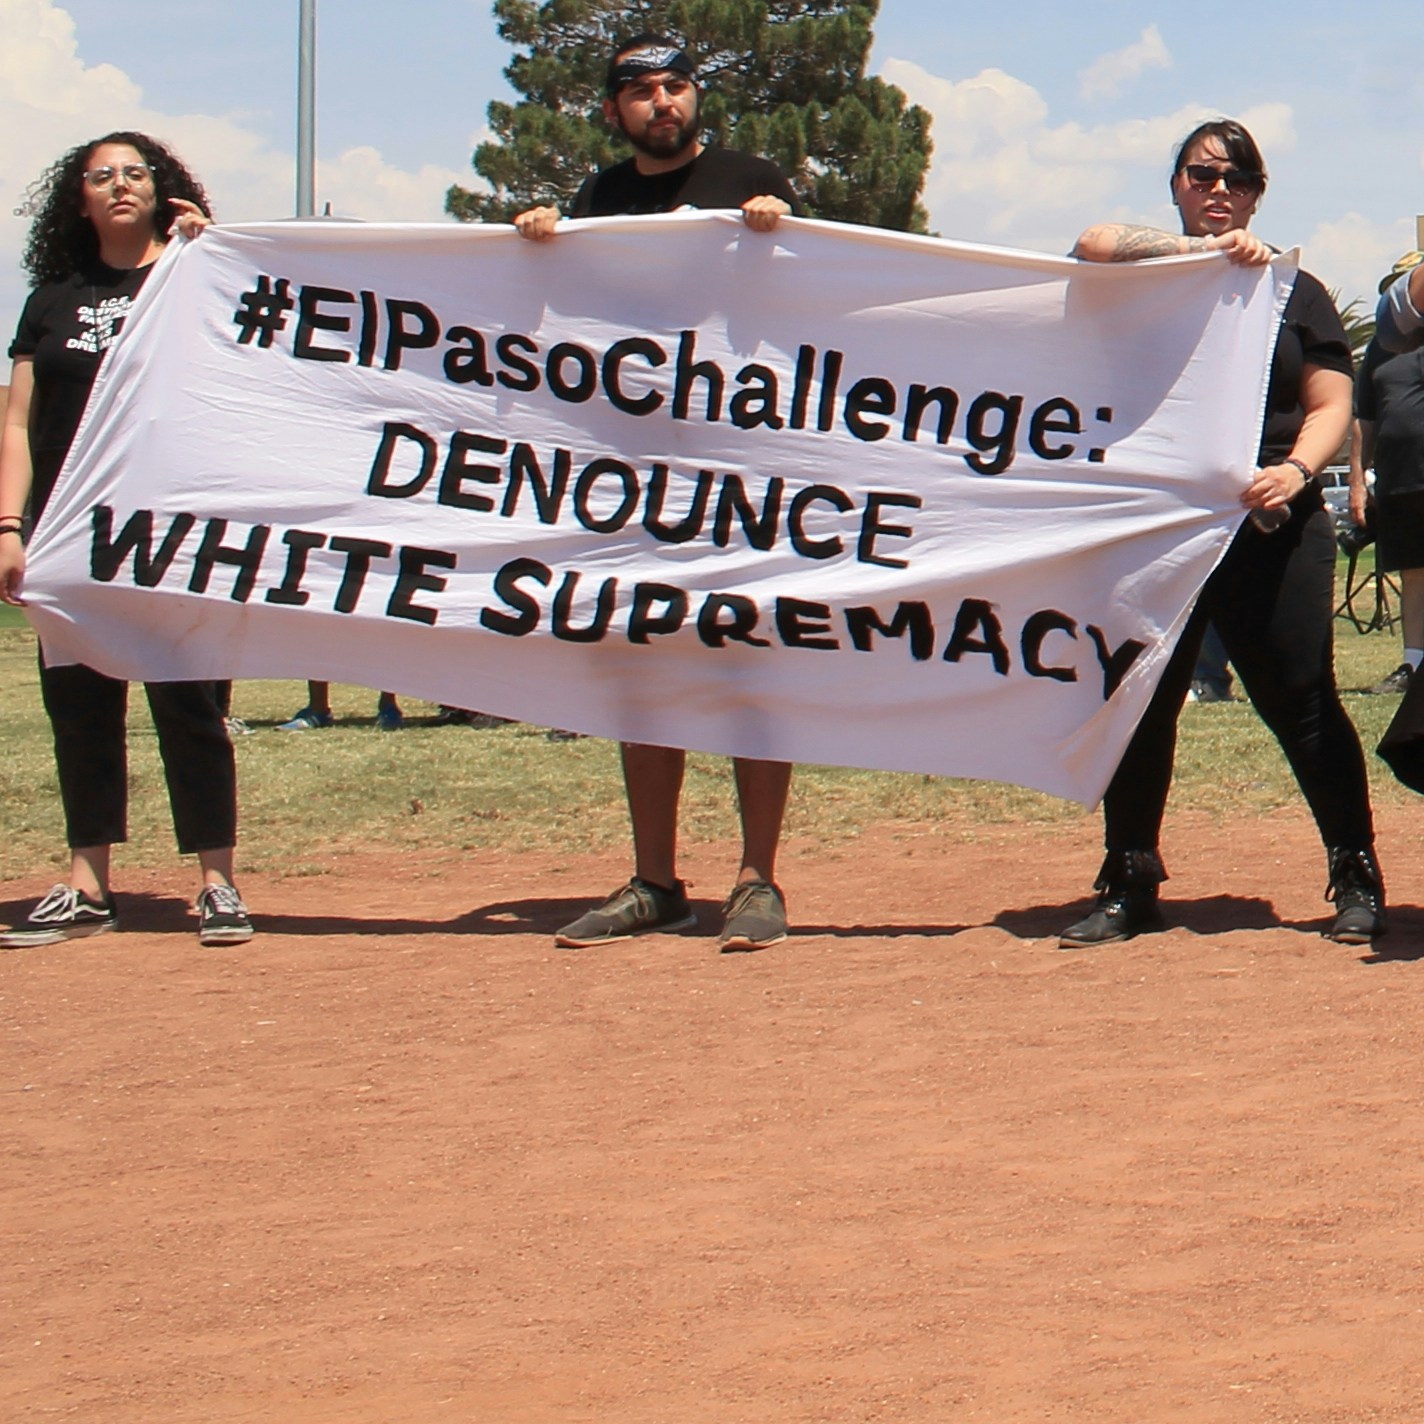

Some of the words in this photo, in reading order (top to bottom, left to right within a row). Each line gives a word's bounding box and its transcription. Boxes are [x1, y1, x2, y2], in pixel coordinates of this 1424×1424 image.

[233, 274, 1112, 476] #ElPasoChallenge:
[366, 421, 923, 569] DENOUNCE
[90, 503, 457, 626] WHITE
[479, 557, 1150, 702] SUPREMACY
